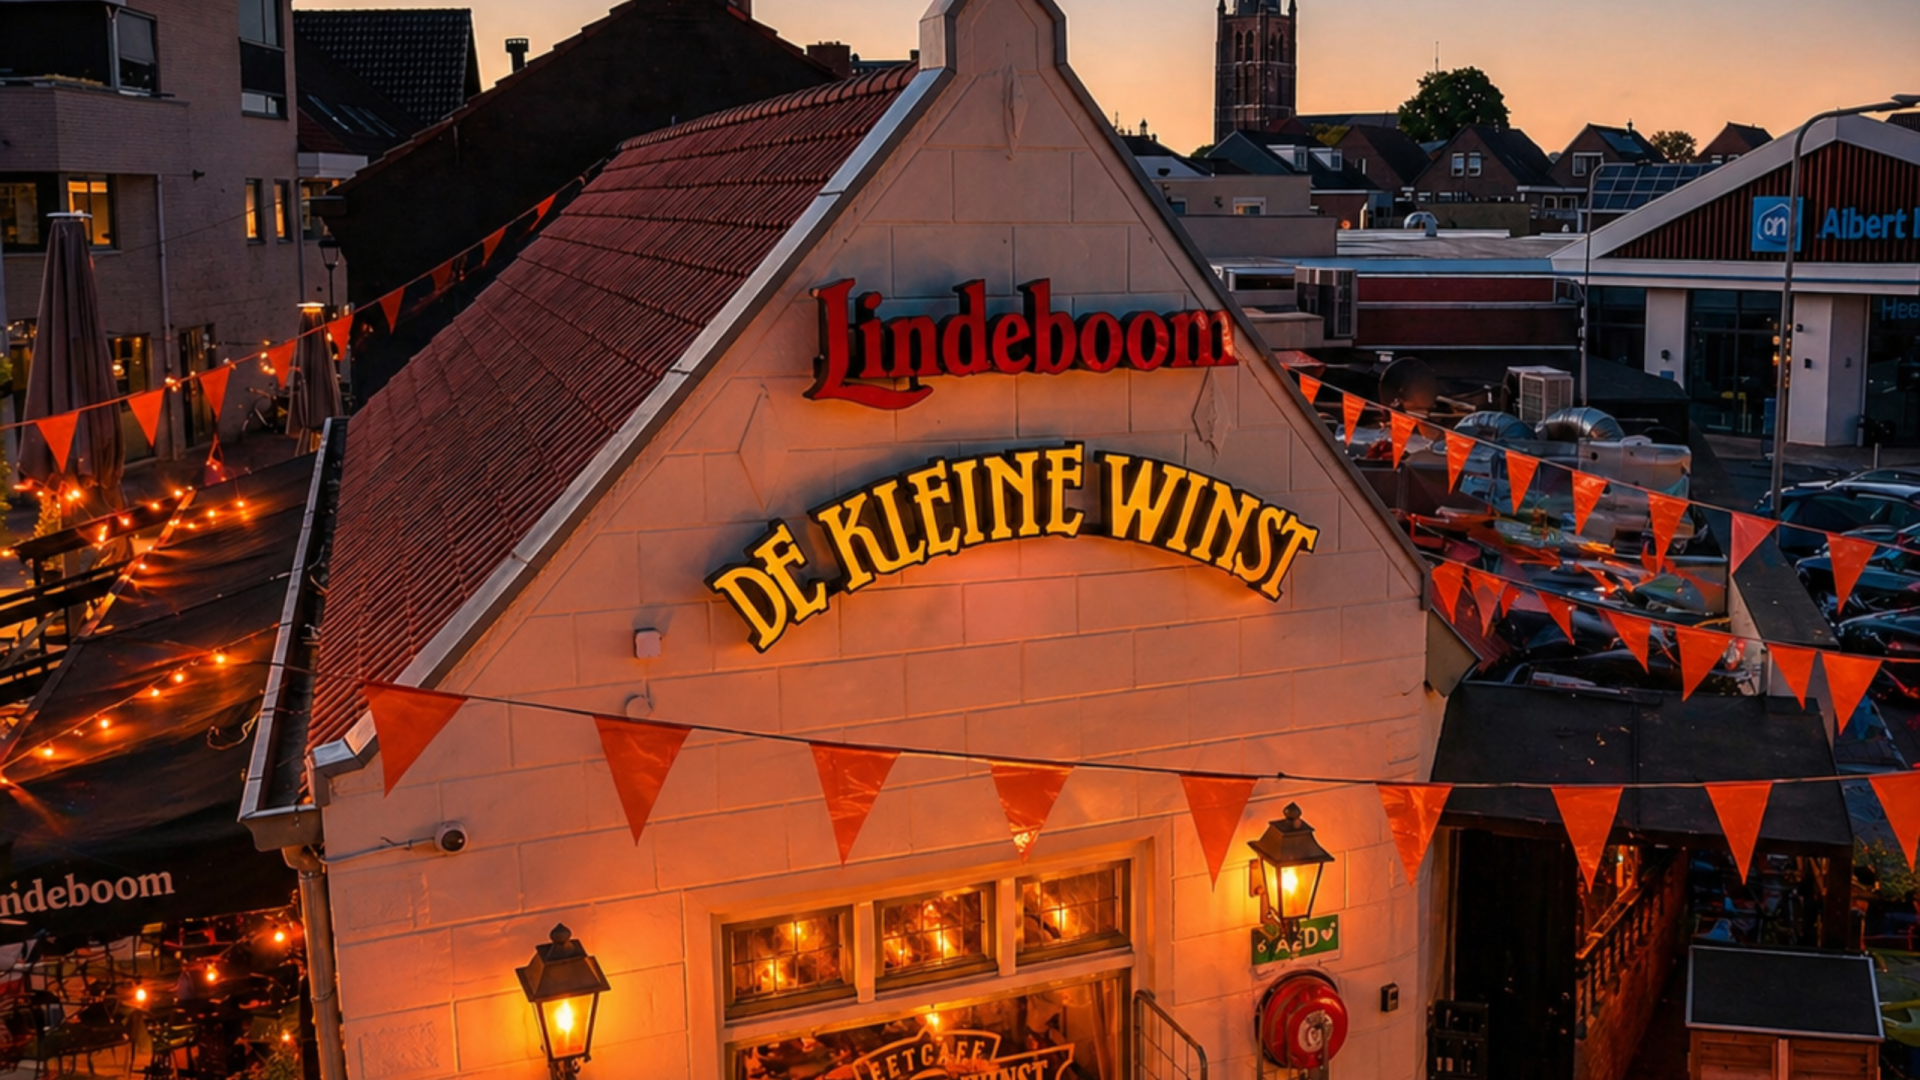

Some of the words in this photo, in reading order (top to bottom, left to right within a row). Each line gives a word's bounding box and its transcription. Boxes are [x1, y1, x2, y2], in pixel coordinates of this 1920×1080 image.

[803, 277, 1239, 410] Lindeboom
[708, 518, 828, 653] DE
[815, 442, 1085, 594] KLEINE
[1101, 451, 1319, 602] WINST
[0, 871, 175, 917] ndeboom
